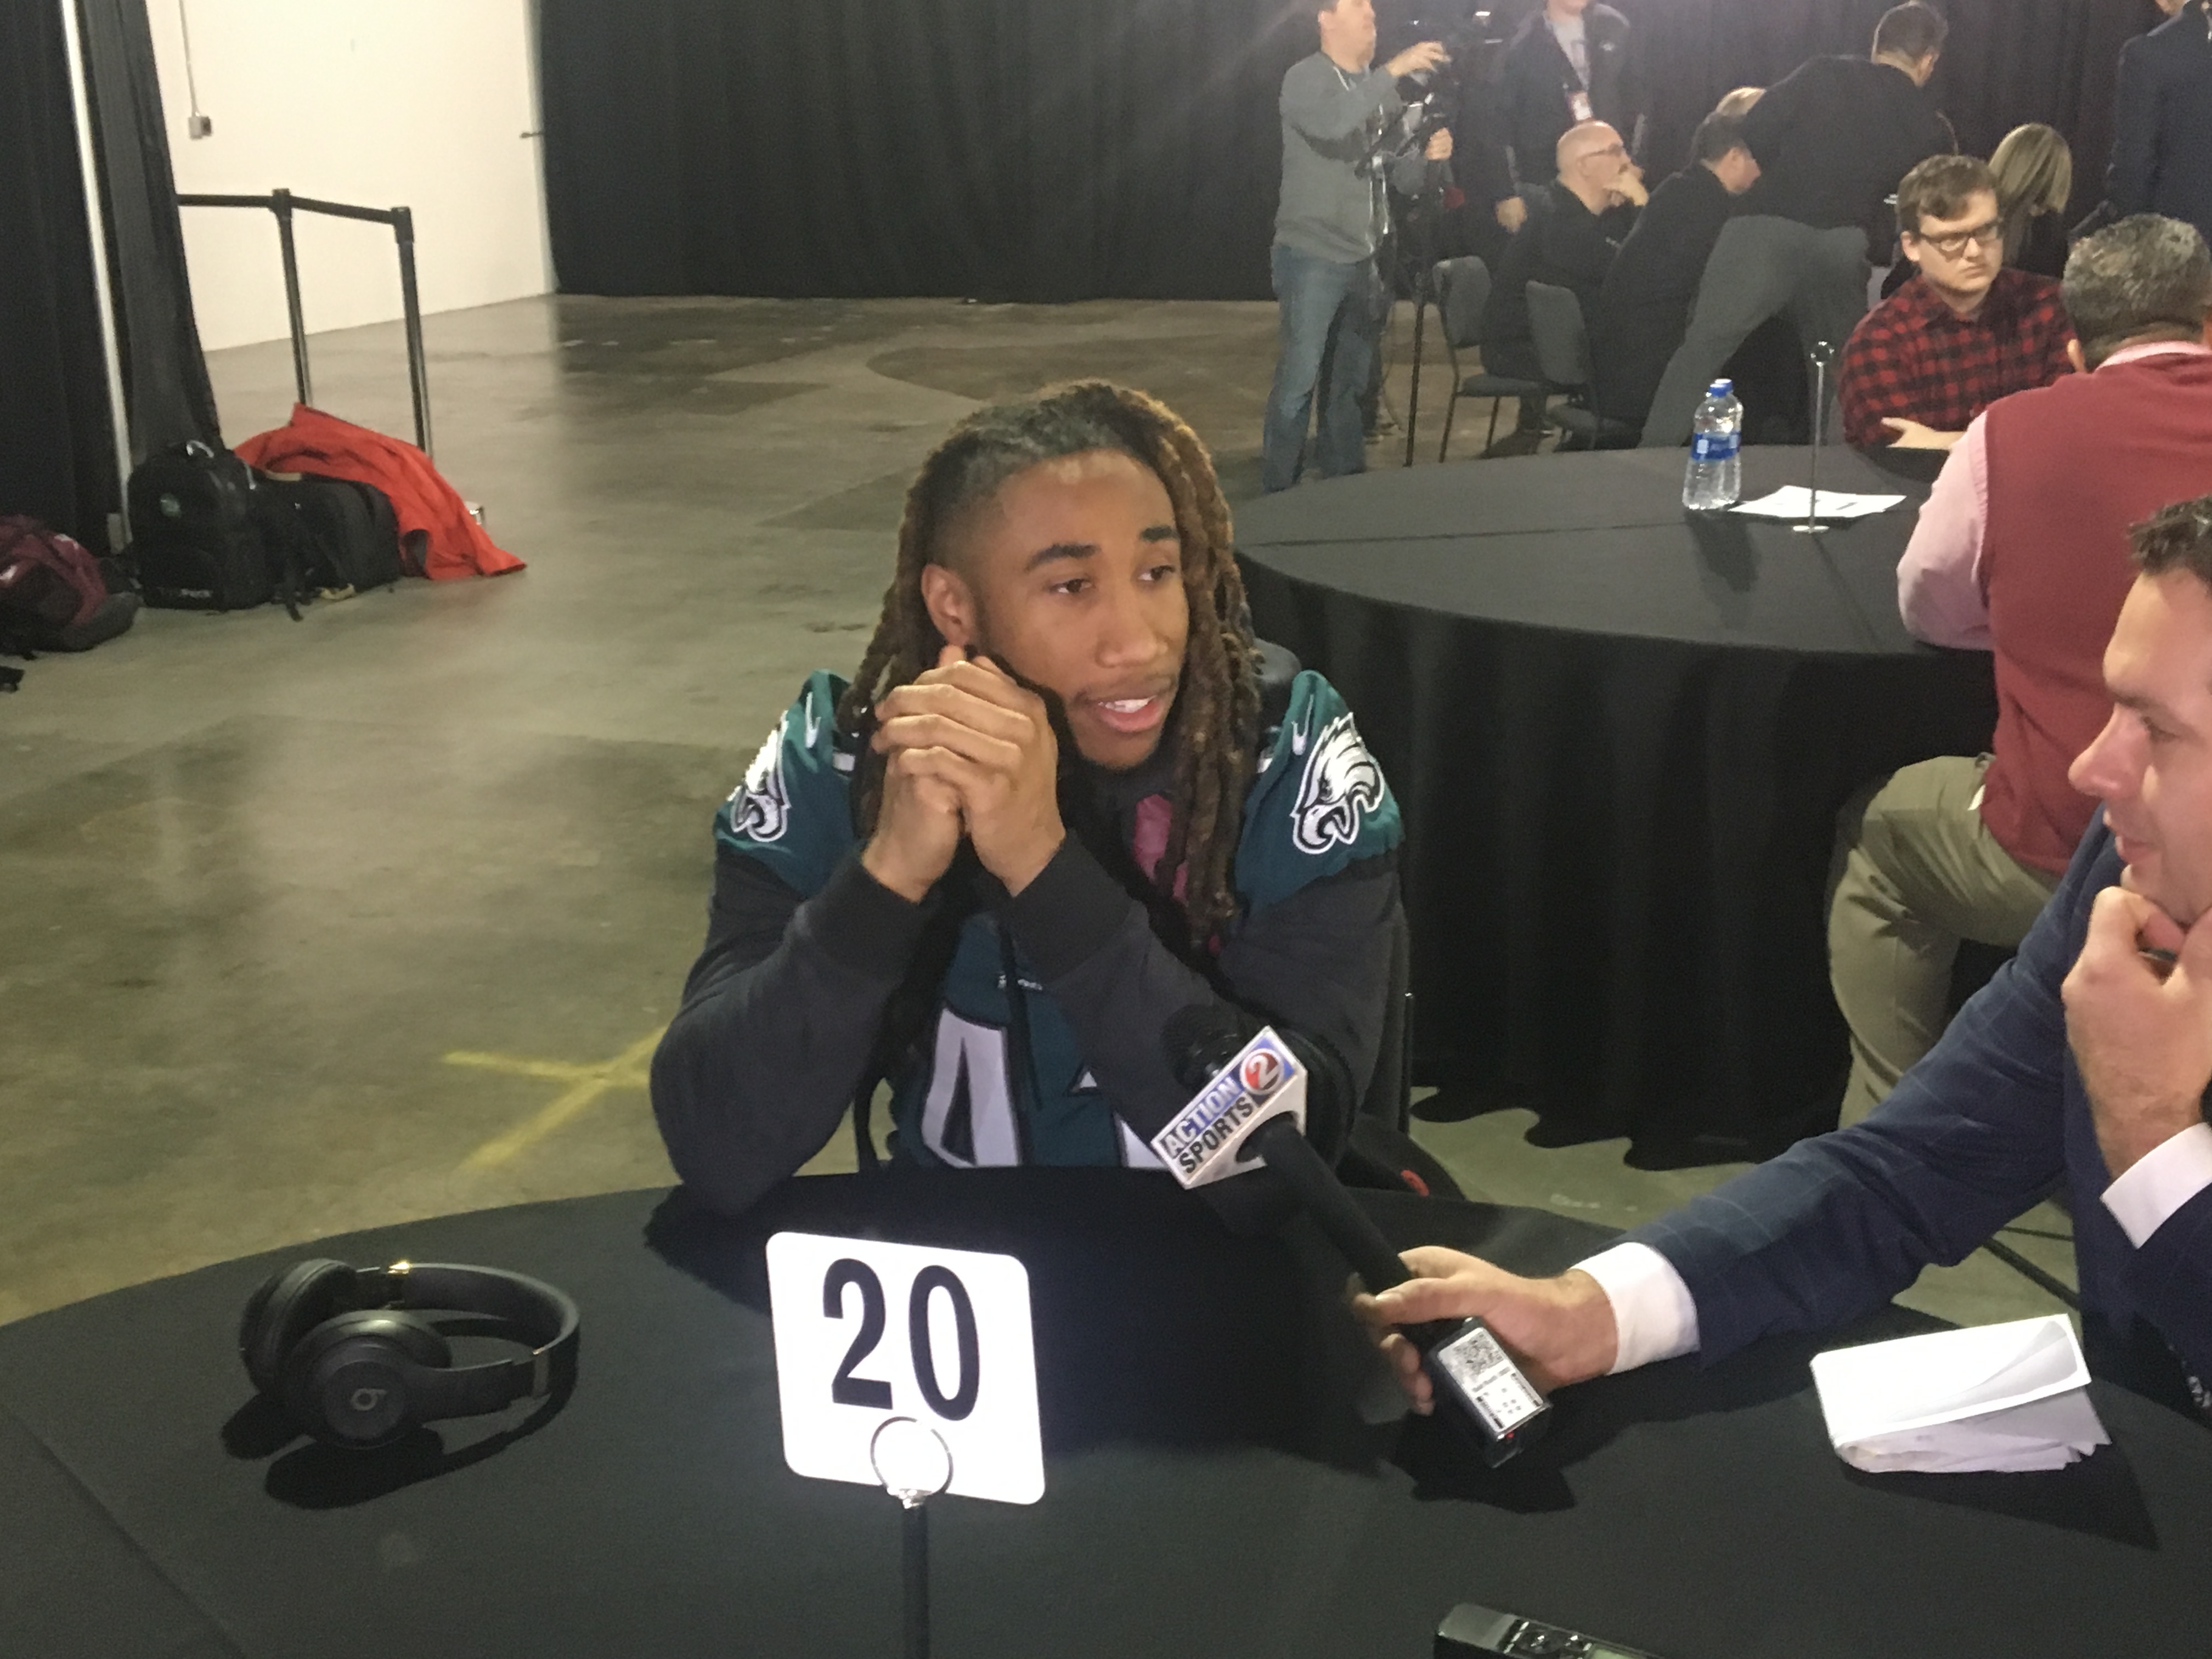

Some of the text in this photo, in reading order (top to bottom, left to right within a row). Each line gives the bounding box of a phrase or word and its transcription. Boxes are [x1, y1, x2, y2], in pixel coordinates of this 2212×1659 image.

[1163, 1053, 1280, 1159] ACTION 2
[1180, 1096, 1254, 1173] SPORTS
[823, 1258, 980, 1421] 20
